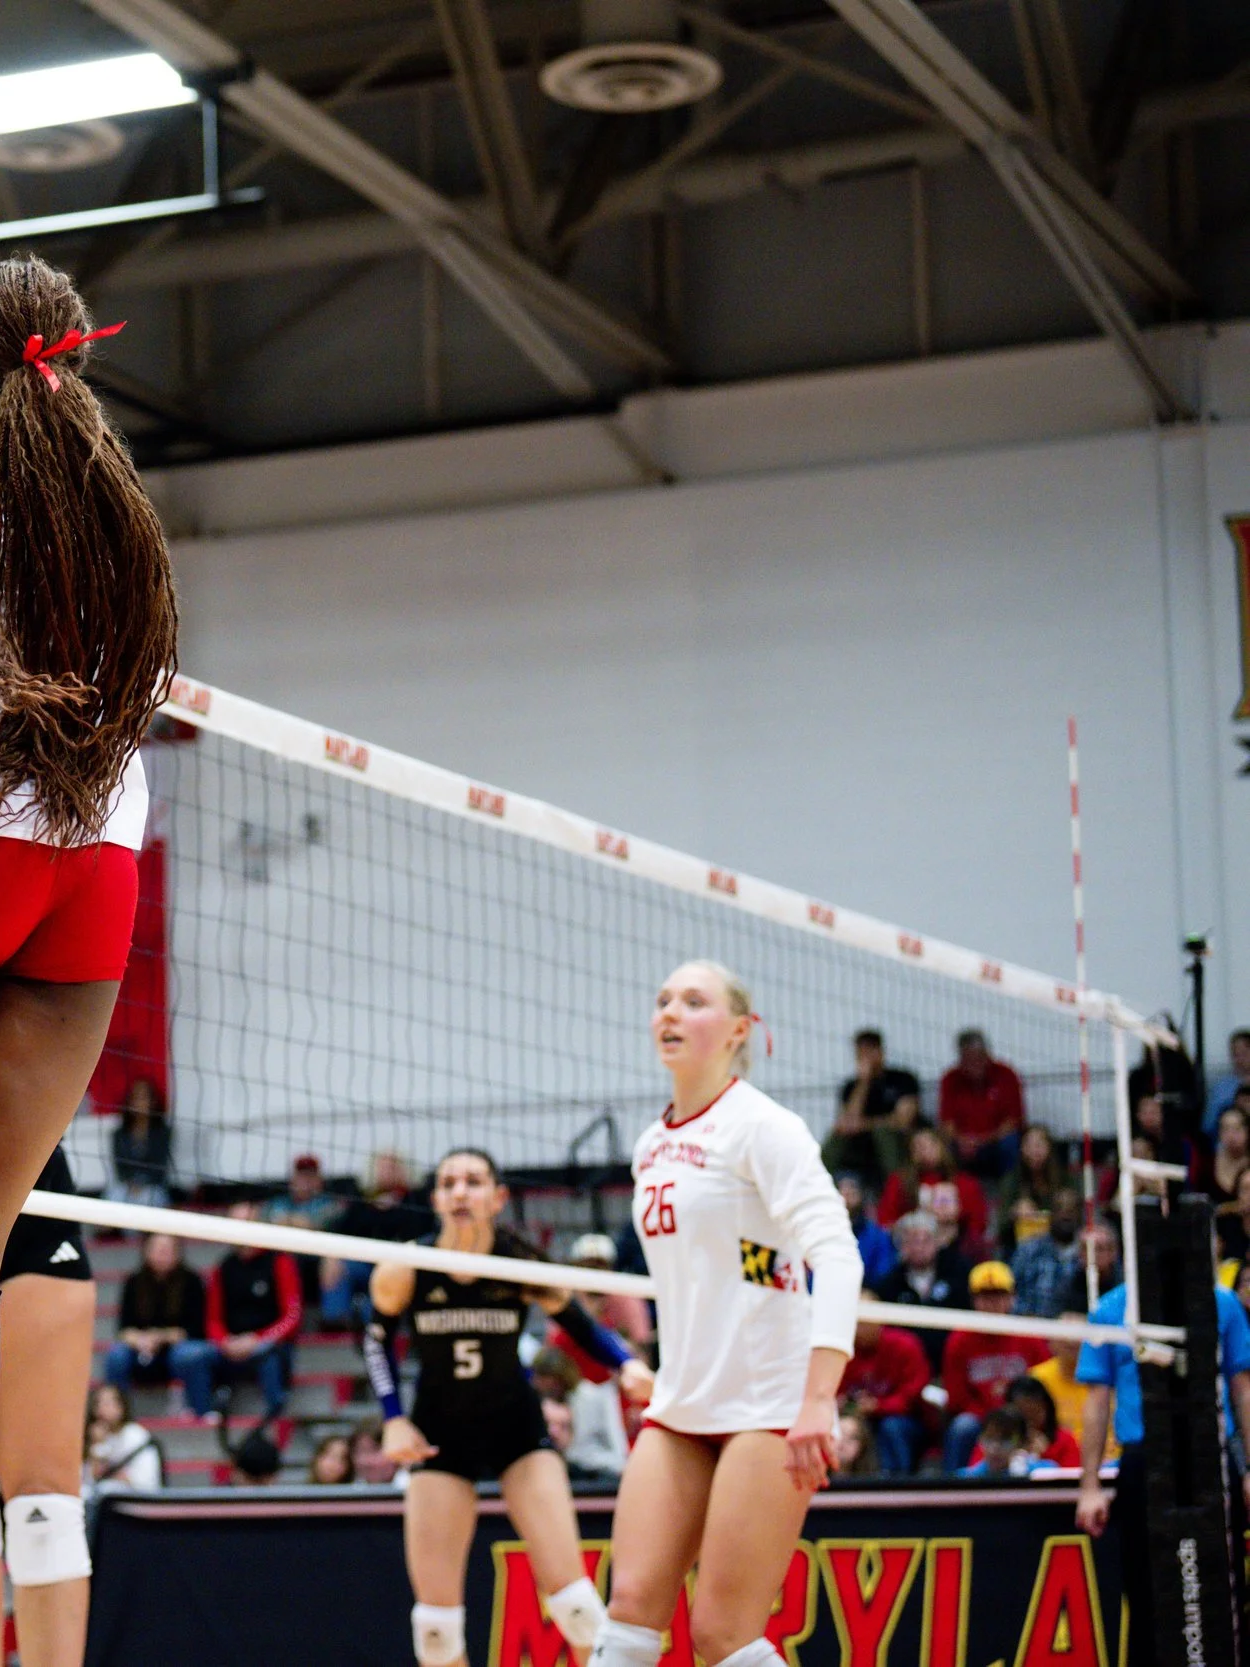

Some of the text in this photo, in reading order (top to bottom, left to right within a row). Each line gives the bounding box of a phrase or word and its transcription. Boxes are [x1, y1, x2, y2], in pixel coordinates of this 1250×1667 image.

[642, 1181, 677, 1237] 26
[453, 1339, 483, 1380] 5
[1177, 1538, 1201, 1603] sports
